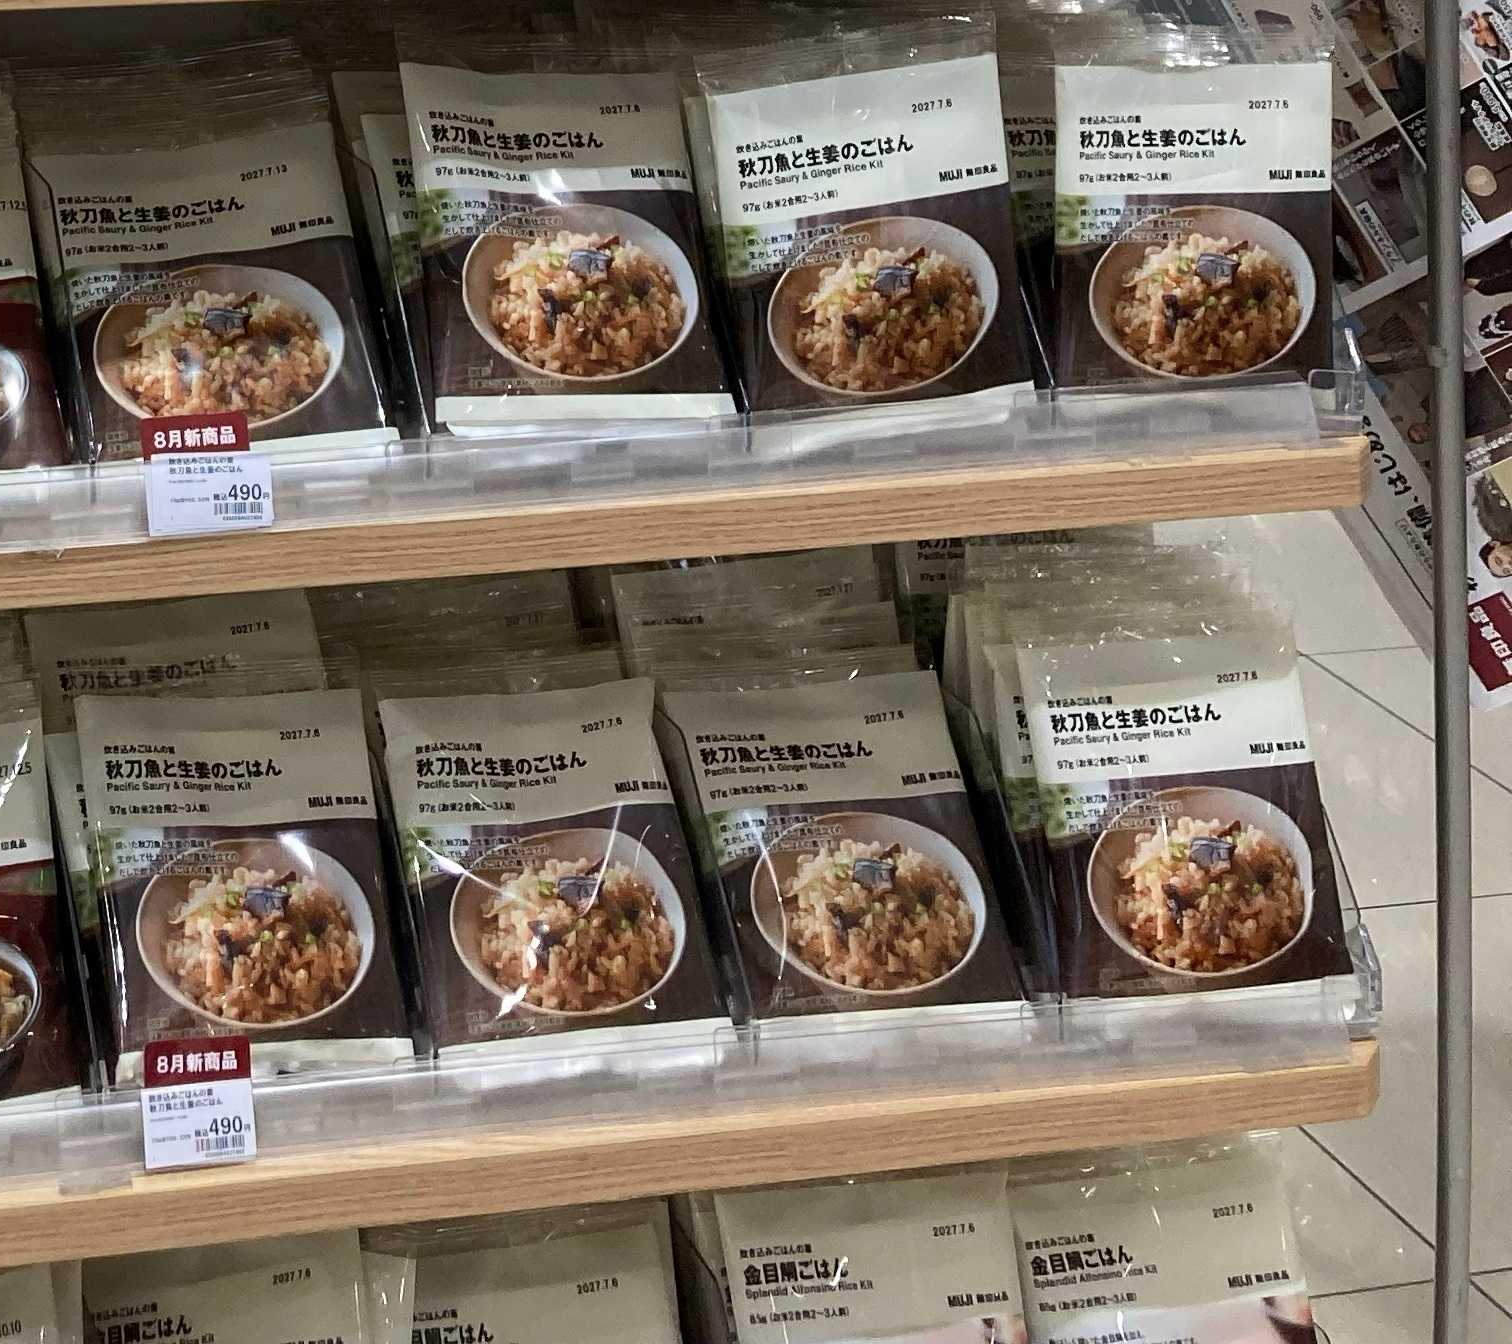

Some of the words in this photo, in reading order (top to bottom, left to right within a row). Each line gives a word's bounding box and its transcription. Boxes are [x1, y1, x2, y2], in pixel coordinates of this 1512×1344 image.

[431, 124, 604, 150] 秋刀魚と生姜のごはん
[1079, 128, 1247, 148] 秋刀魚と生姜のごはん
[738, 134, 914, 178] 秋刀魚と生姜のごはん
[1079, 151, 1106, 161] Pacific
[1108, 151, 1133, 162] Saury
[1145, 150, 1176, 161] Ginger
[1179, 150, 1200, 158] Rice
[1202, 149, 1215, 158] Kit
[740, 176, 772, 190] Pacific
[775, 173, 800, 185] Saury
[802, 172, 809, 180] &
[810, 166, 842, 180] Ginger
[844, 163, 867, 173] Rice
[869, 160, 883, 169] Kit
[939, 169, 963, 182] MUJI
[1268, 169, 1292, 180] MUJI
[60, 197, 244, 226] 秋刀魚と生姜のごはん
[270, 224, 296, 236] MUJI
[154, 426, 237, 448] 8月新商品
[1051, 703, 1221, 733] 秋刀魚と生姜のごはん
[700, 741, 873, 766] 秋刀魚と生姜のごはん
[1250, 742, 1274, 754] MUJI
[105, 759, 282, 779] 秋刀魚と生姜のごはん
[416, 751, 587, 777] 秋刀魚と生姜のごはん
[901, 773, 926, 785] MUJI
[308, 796, 333, 808] MUJI
[157, 1051, 237, 1073] 8月新商品
[743, 1257, 849, 1286] 金目鯛ごはん
[1031, 1245, 1133, 1276] 金目鯛ごはん
